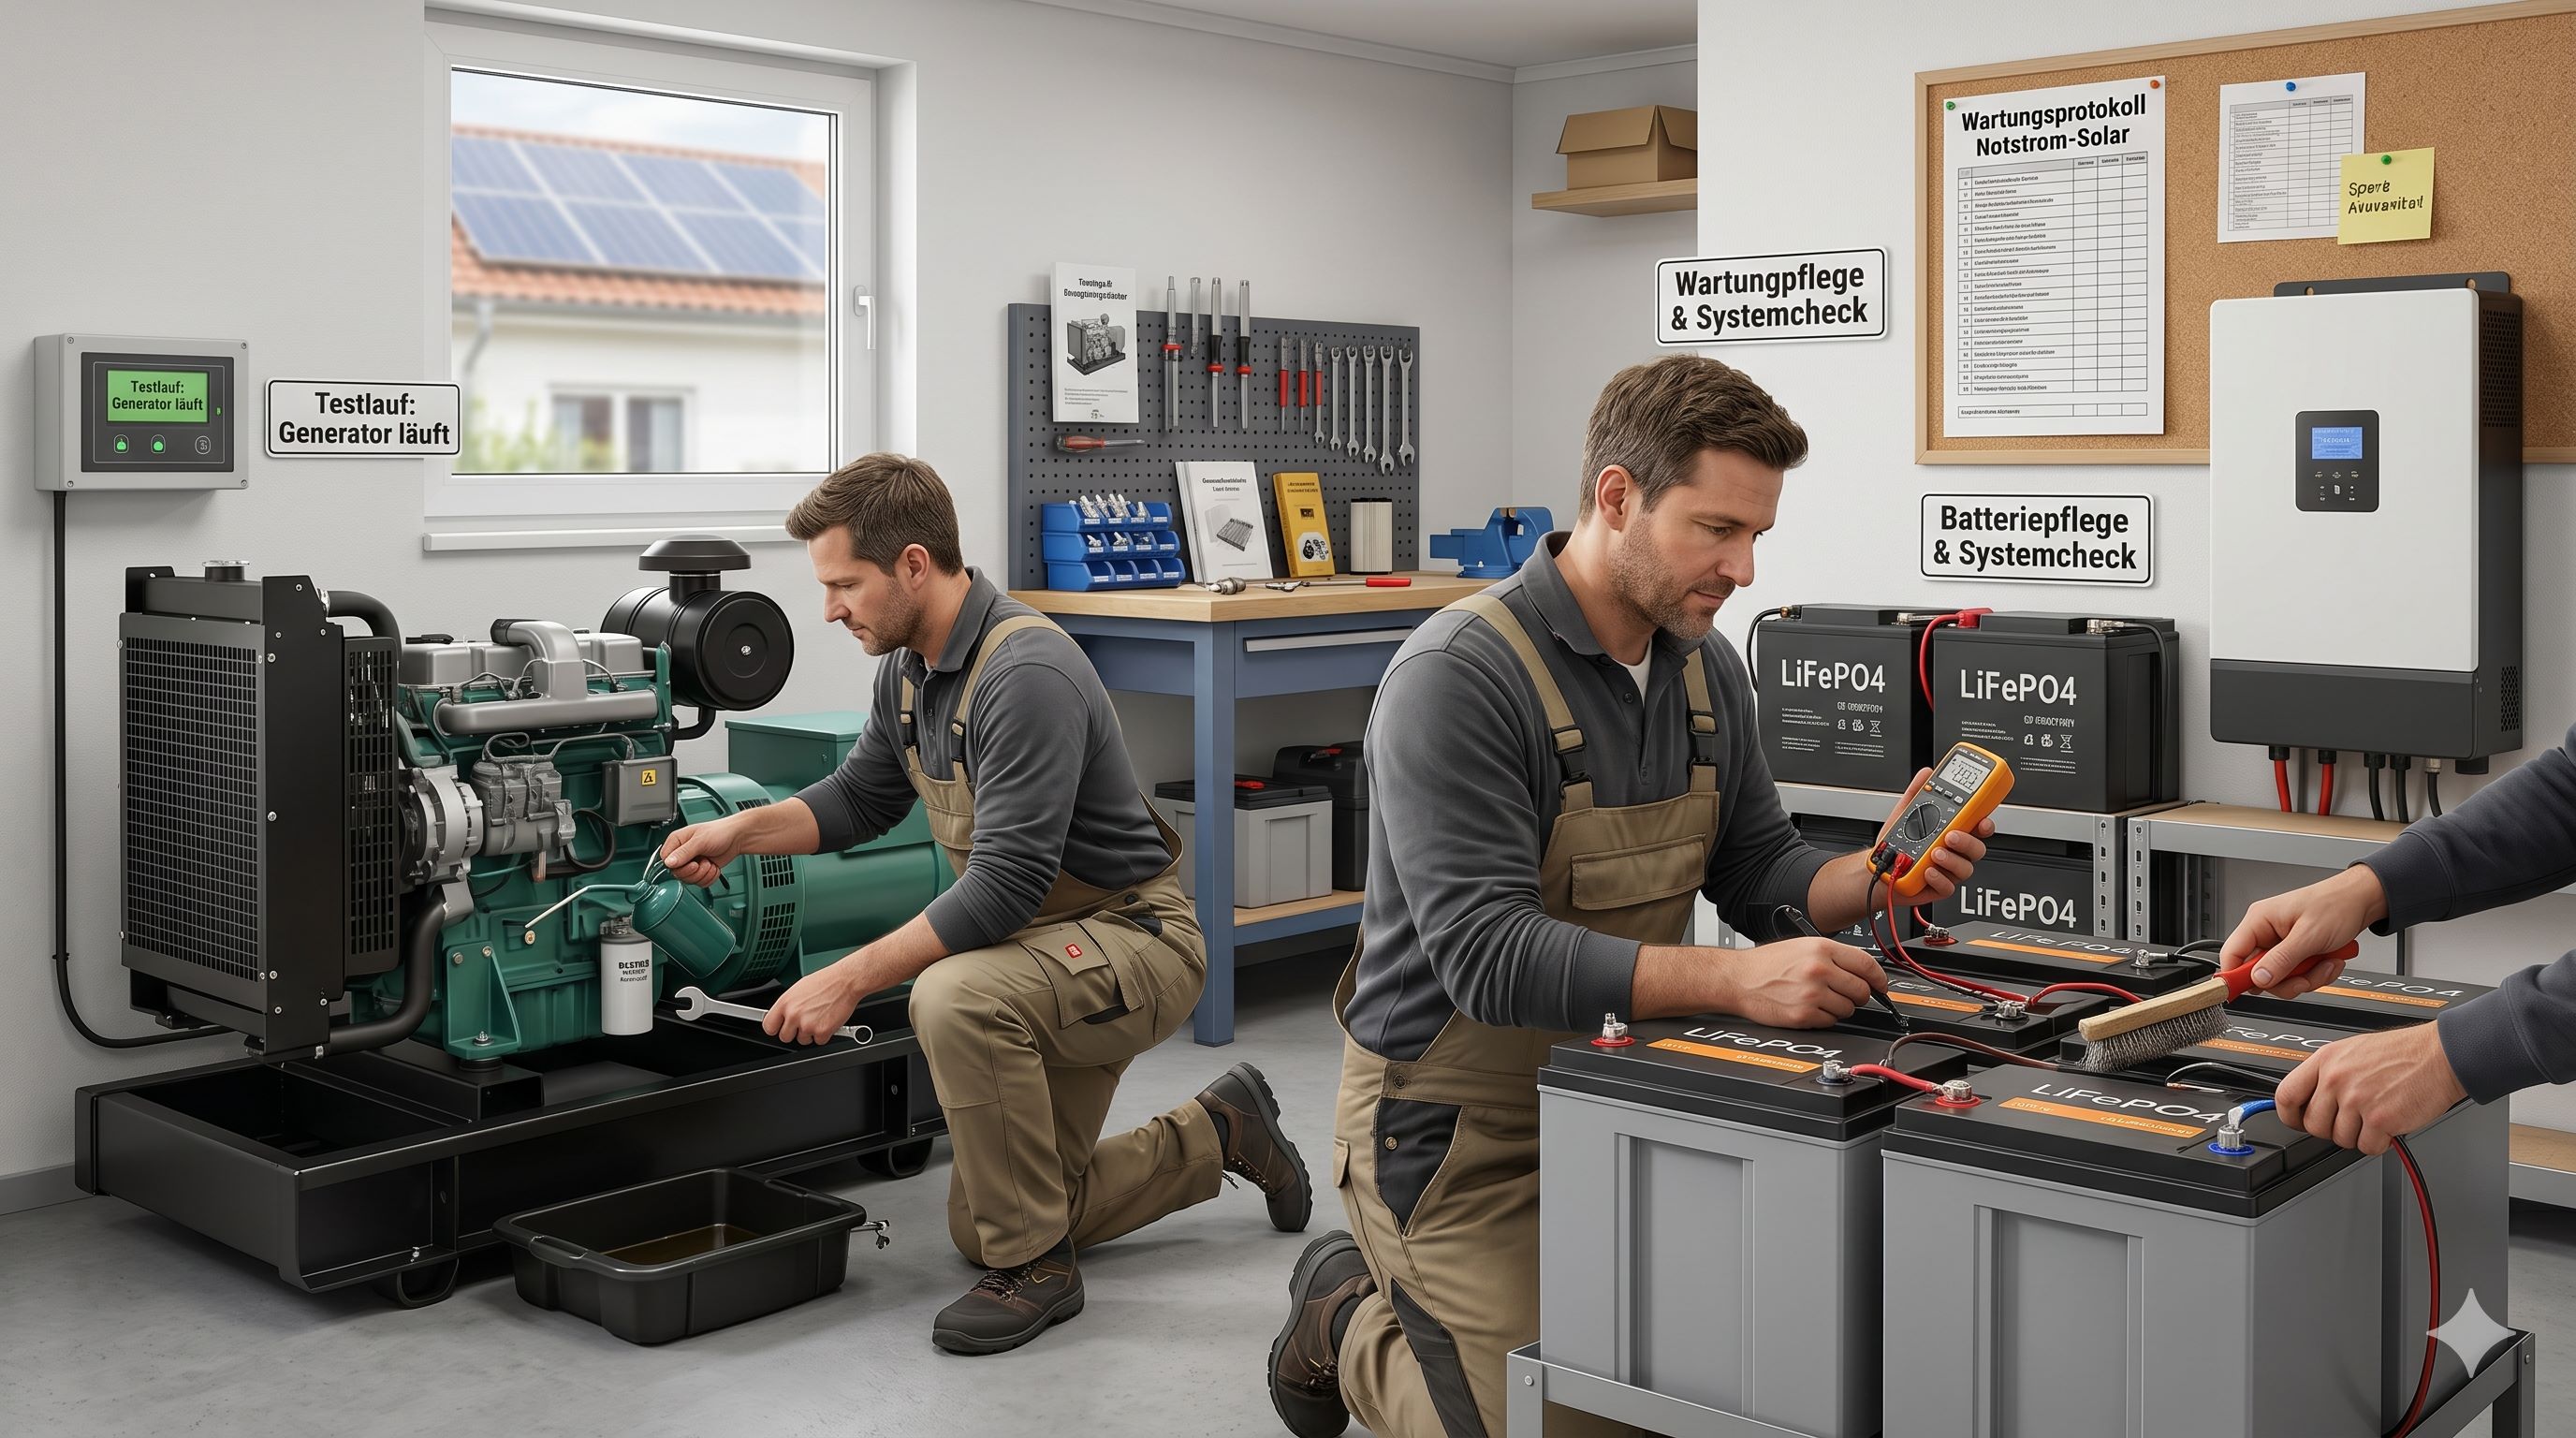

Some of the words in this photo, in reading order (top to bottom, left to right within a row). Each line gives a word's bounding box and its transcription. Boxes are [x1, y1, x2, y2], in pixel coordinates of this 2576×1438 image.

[1962, 94, 2146, 131] Wartungsprotokoll
[1977, 125, 2130, 156] Notstrom-Solar
[1675, 262, 1865, 299] Wartungpflege
[1671, 305, 1688, 330] &
[1696, 295, 1868, 336] Systemcheck
[112, 397, 171, 410] Generator
[175, 398, 203, 411] läuft
[131, 380, 184, 394] Testlauf:
[315, 391, 416, 416] Testlauf:
[279, 421, 392, 444] Generator
[399, 422, 450, 445] läuft
[1940, 505, 2129, 539] Batteriepflege
[1933, 539, 1951, 565] &
[1959, 540, 2137, 572] Systemcheck
[1781, 659, 1886, 693] LiFePO4
[1961, 668, 2077, 706] LiFePO4
[1960, 886, 2077, 928] LiFePO4
